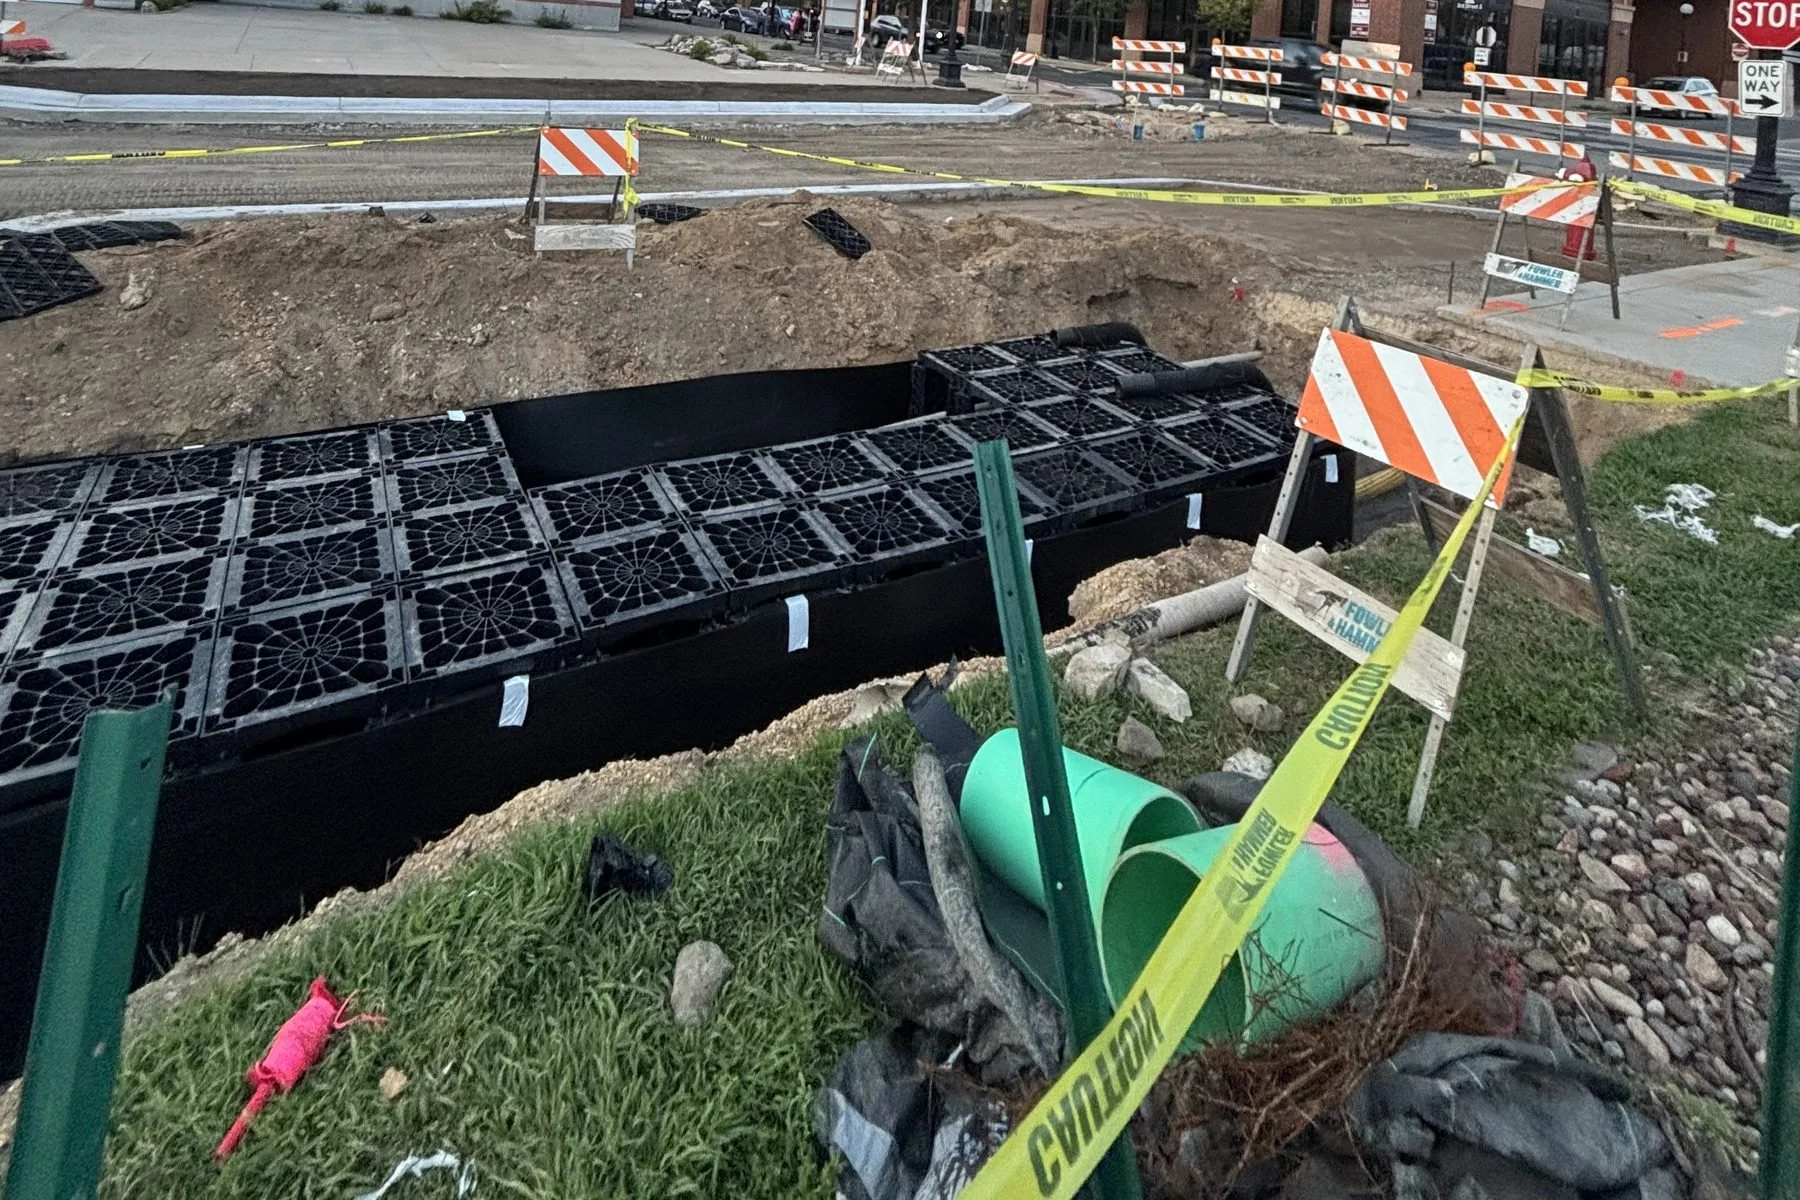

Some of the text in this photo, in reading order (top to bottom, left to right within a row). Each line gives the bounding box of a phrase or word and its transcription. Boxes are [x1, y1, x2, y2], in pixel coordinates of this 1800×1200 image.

[1735, 2, 1800, 28] STOP
[1746, 65, 1779, 78] ONE
[1745, 80, 1780, 92] WAY
[1527, 264, 1564, 280] FOWLER
[1346, 601, 1393, 637] FOWL
